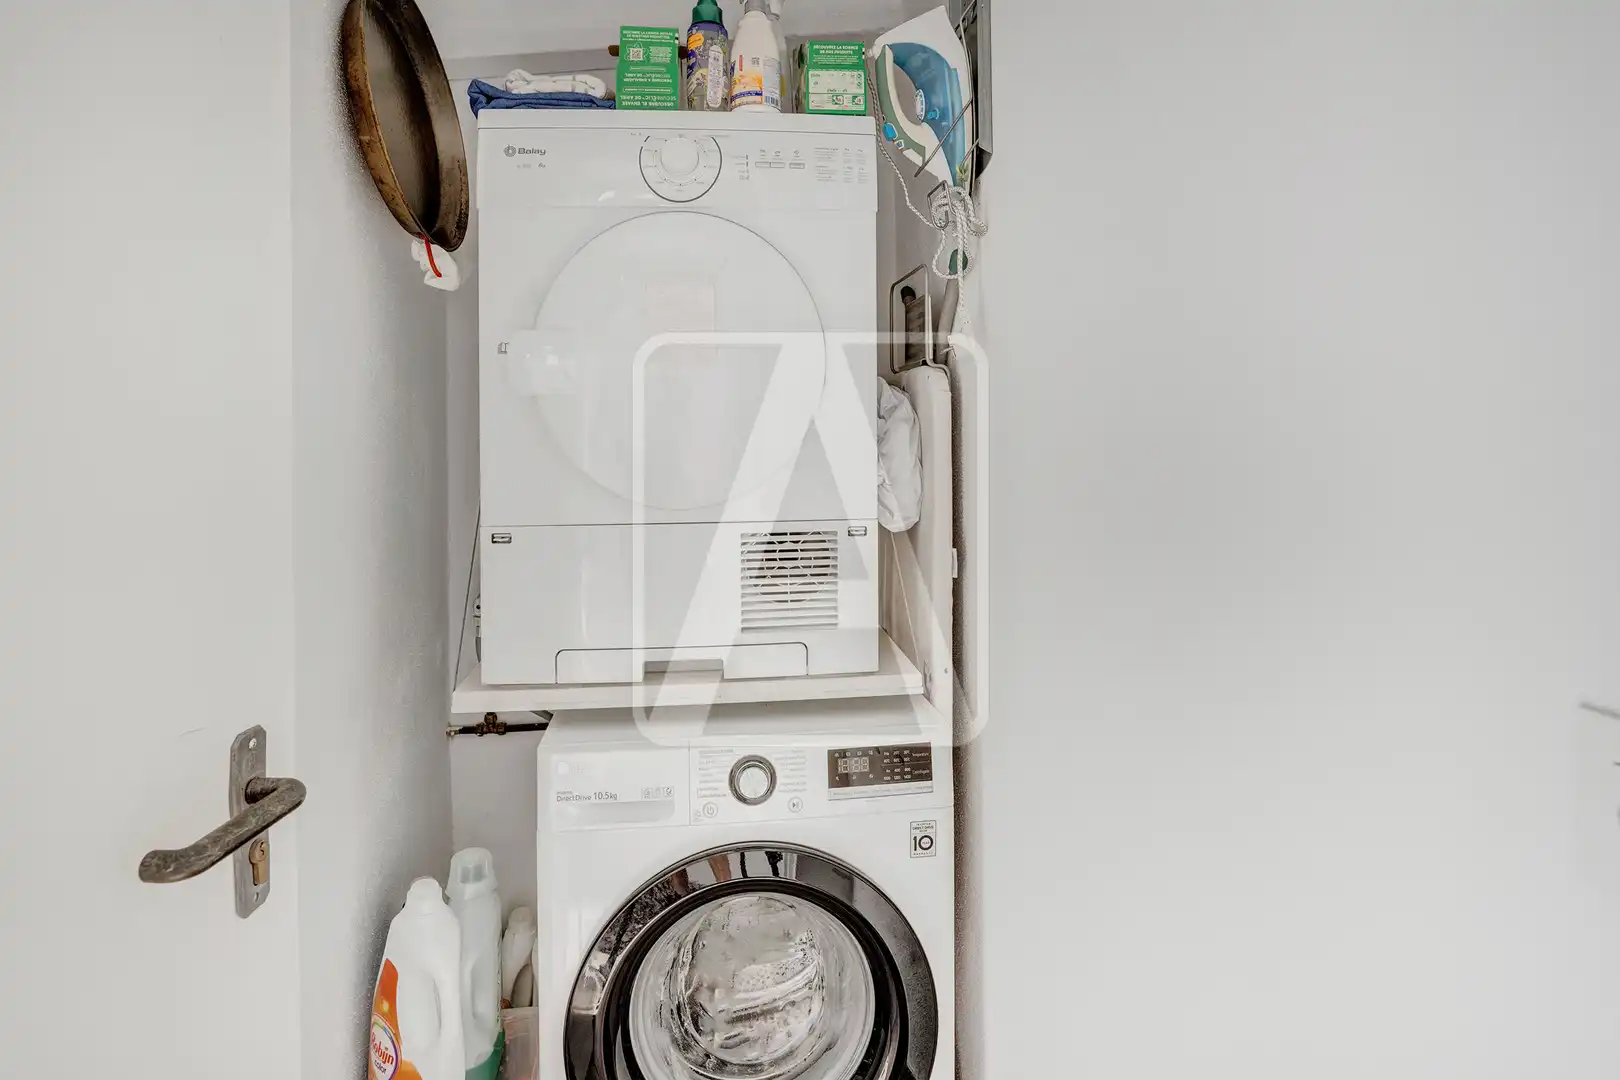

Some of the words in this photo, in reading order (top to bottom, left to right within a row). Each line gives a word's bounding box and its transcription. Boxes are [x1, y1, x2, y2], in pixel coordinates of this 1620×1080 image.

[517, 147, 546, 156] Balay
[912, 834, 934, 852] 10
[371, 1031, 394, 1065] Robijn
